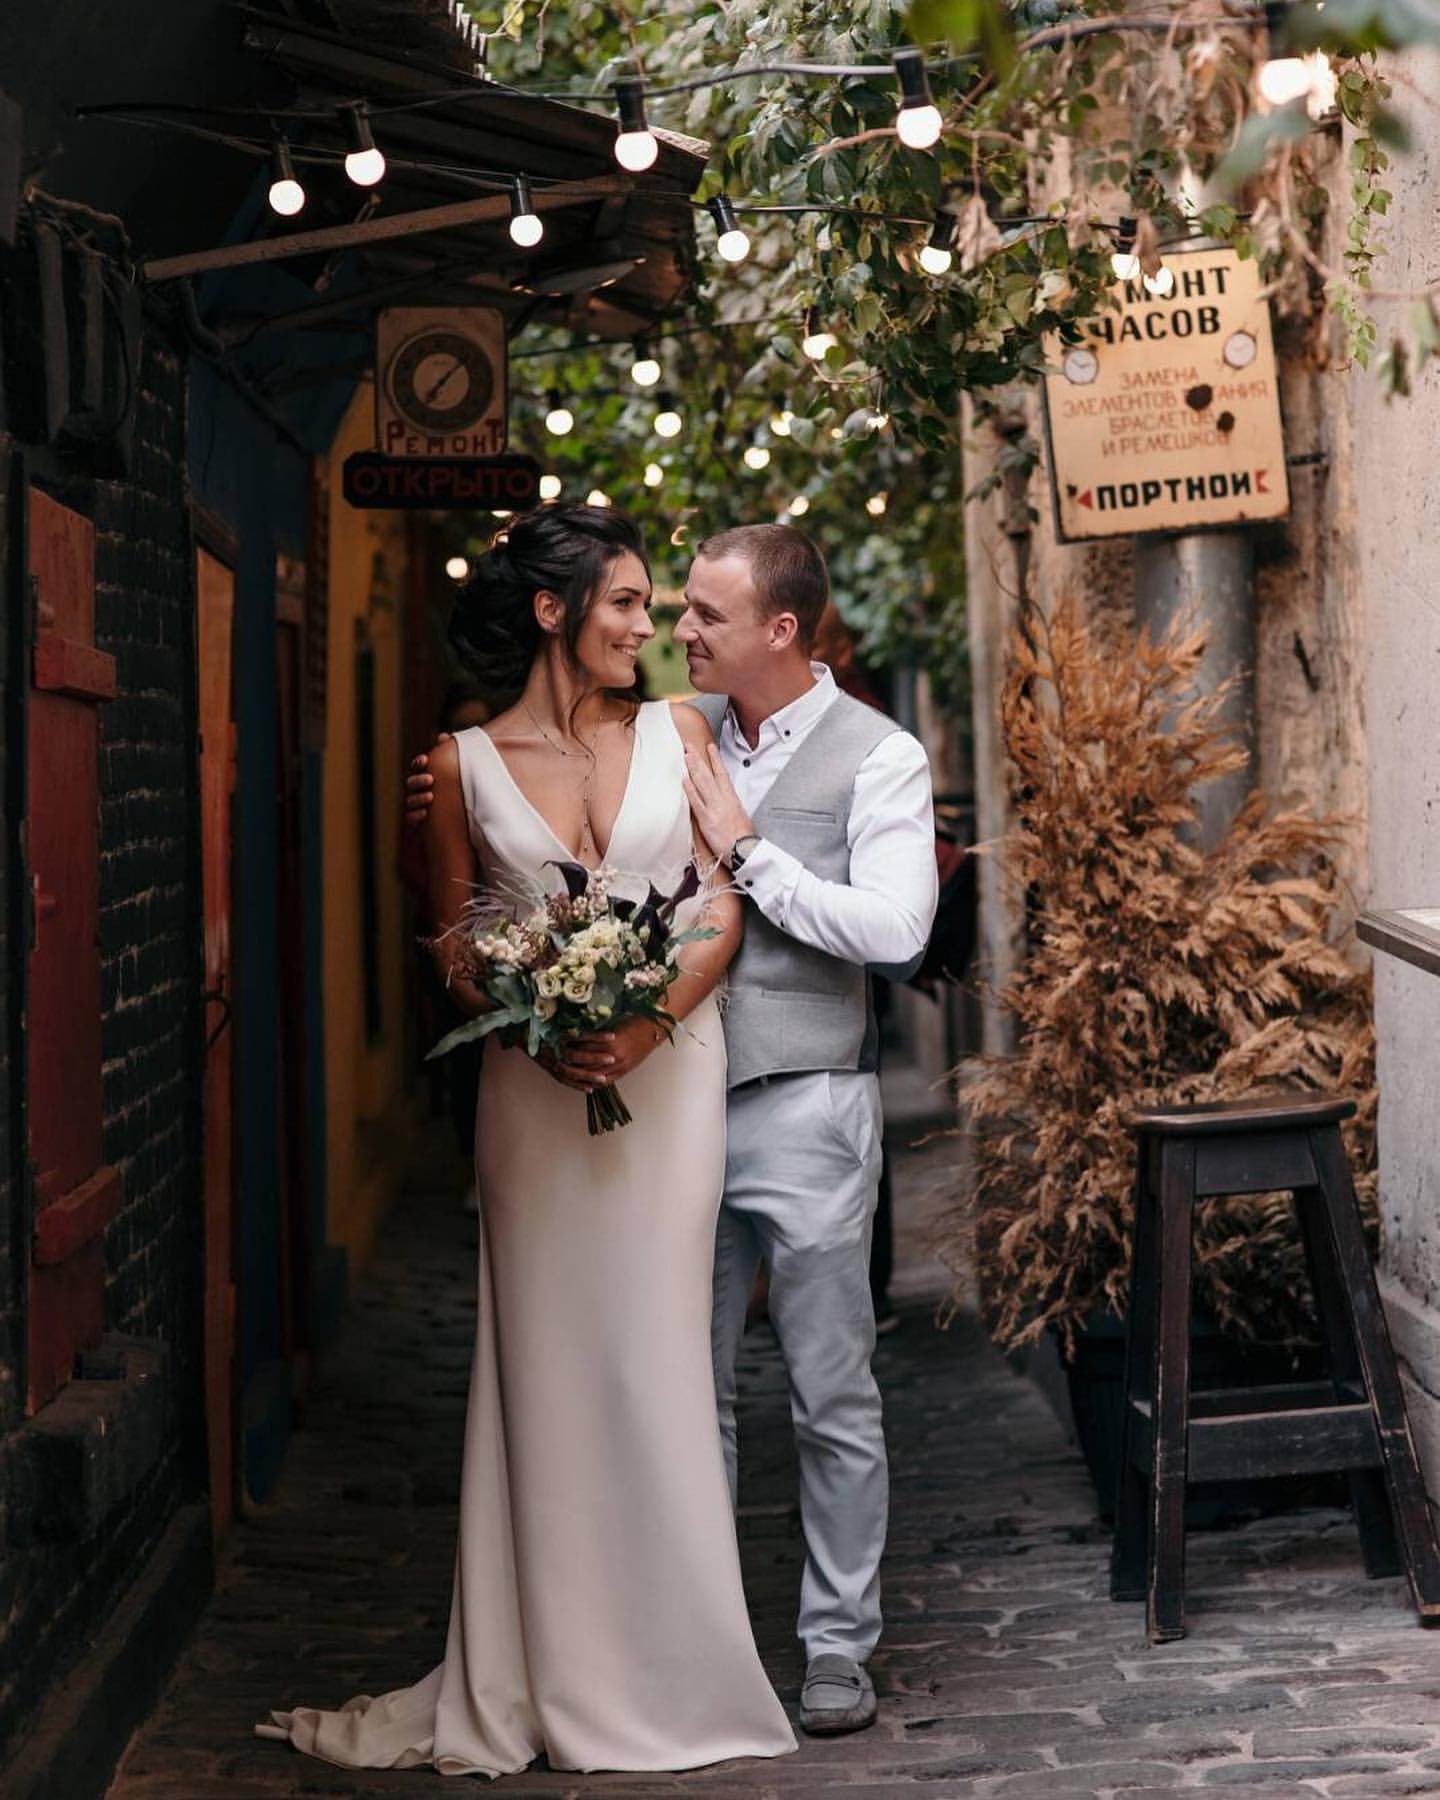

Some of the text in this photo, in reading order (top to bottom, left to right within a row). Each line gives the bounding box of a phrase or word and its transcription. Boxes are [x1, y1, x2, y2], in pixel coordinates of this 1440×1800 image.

[1088, 306, 1221, 345] ЧАСОВ
[1119, 366, 1200, 391] ЗАМЕНА
[1063, 389, 1177, 418] ЭЛЕМЕНТОВ
[1108, 409, 1217, 436] БРАСЛЕТОВ
[1118, 430, 1232, 456] РЕМЕШКОВ
[352, 465, 534, 500] ОТКРЫТО
